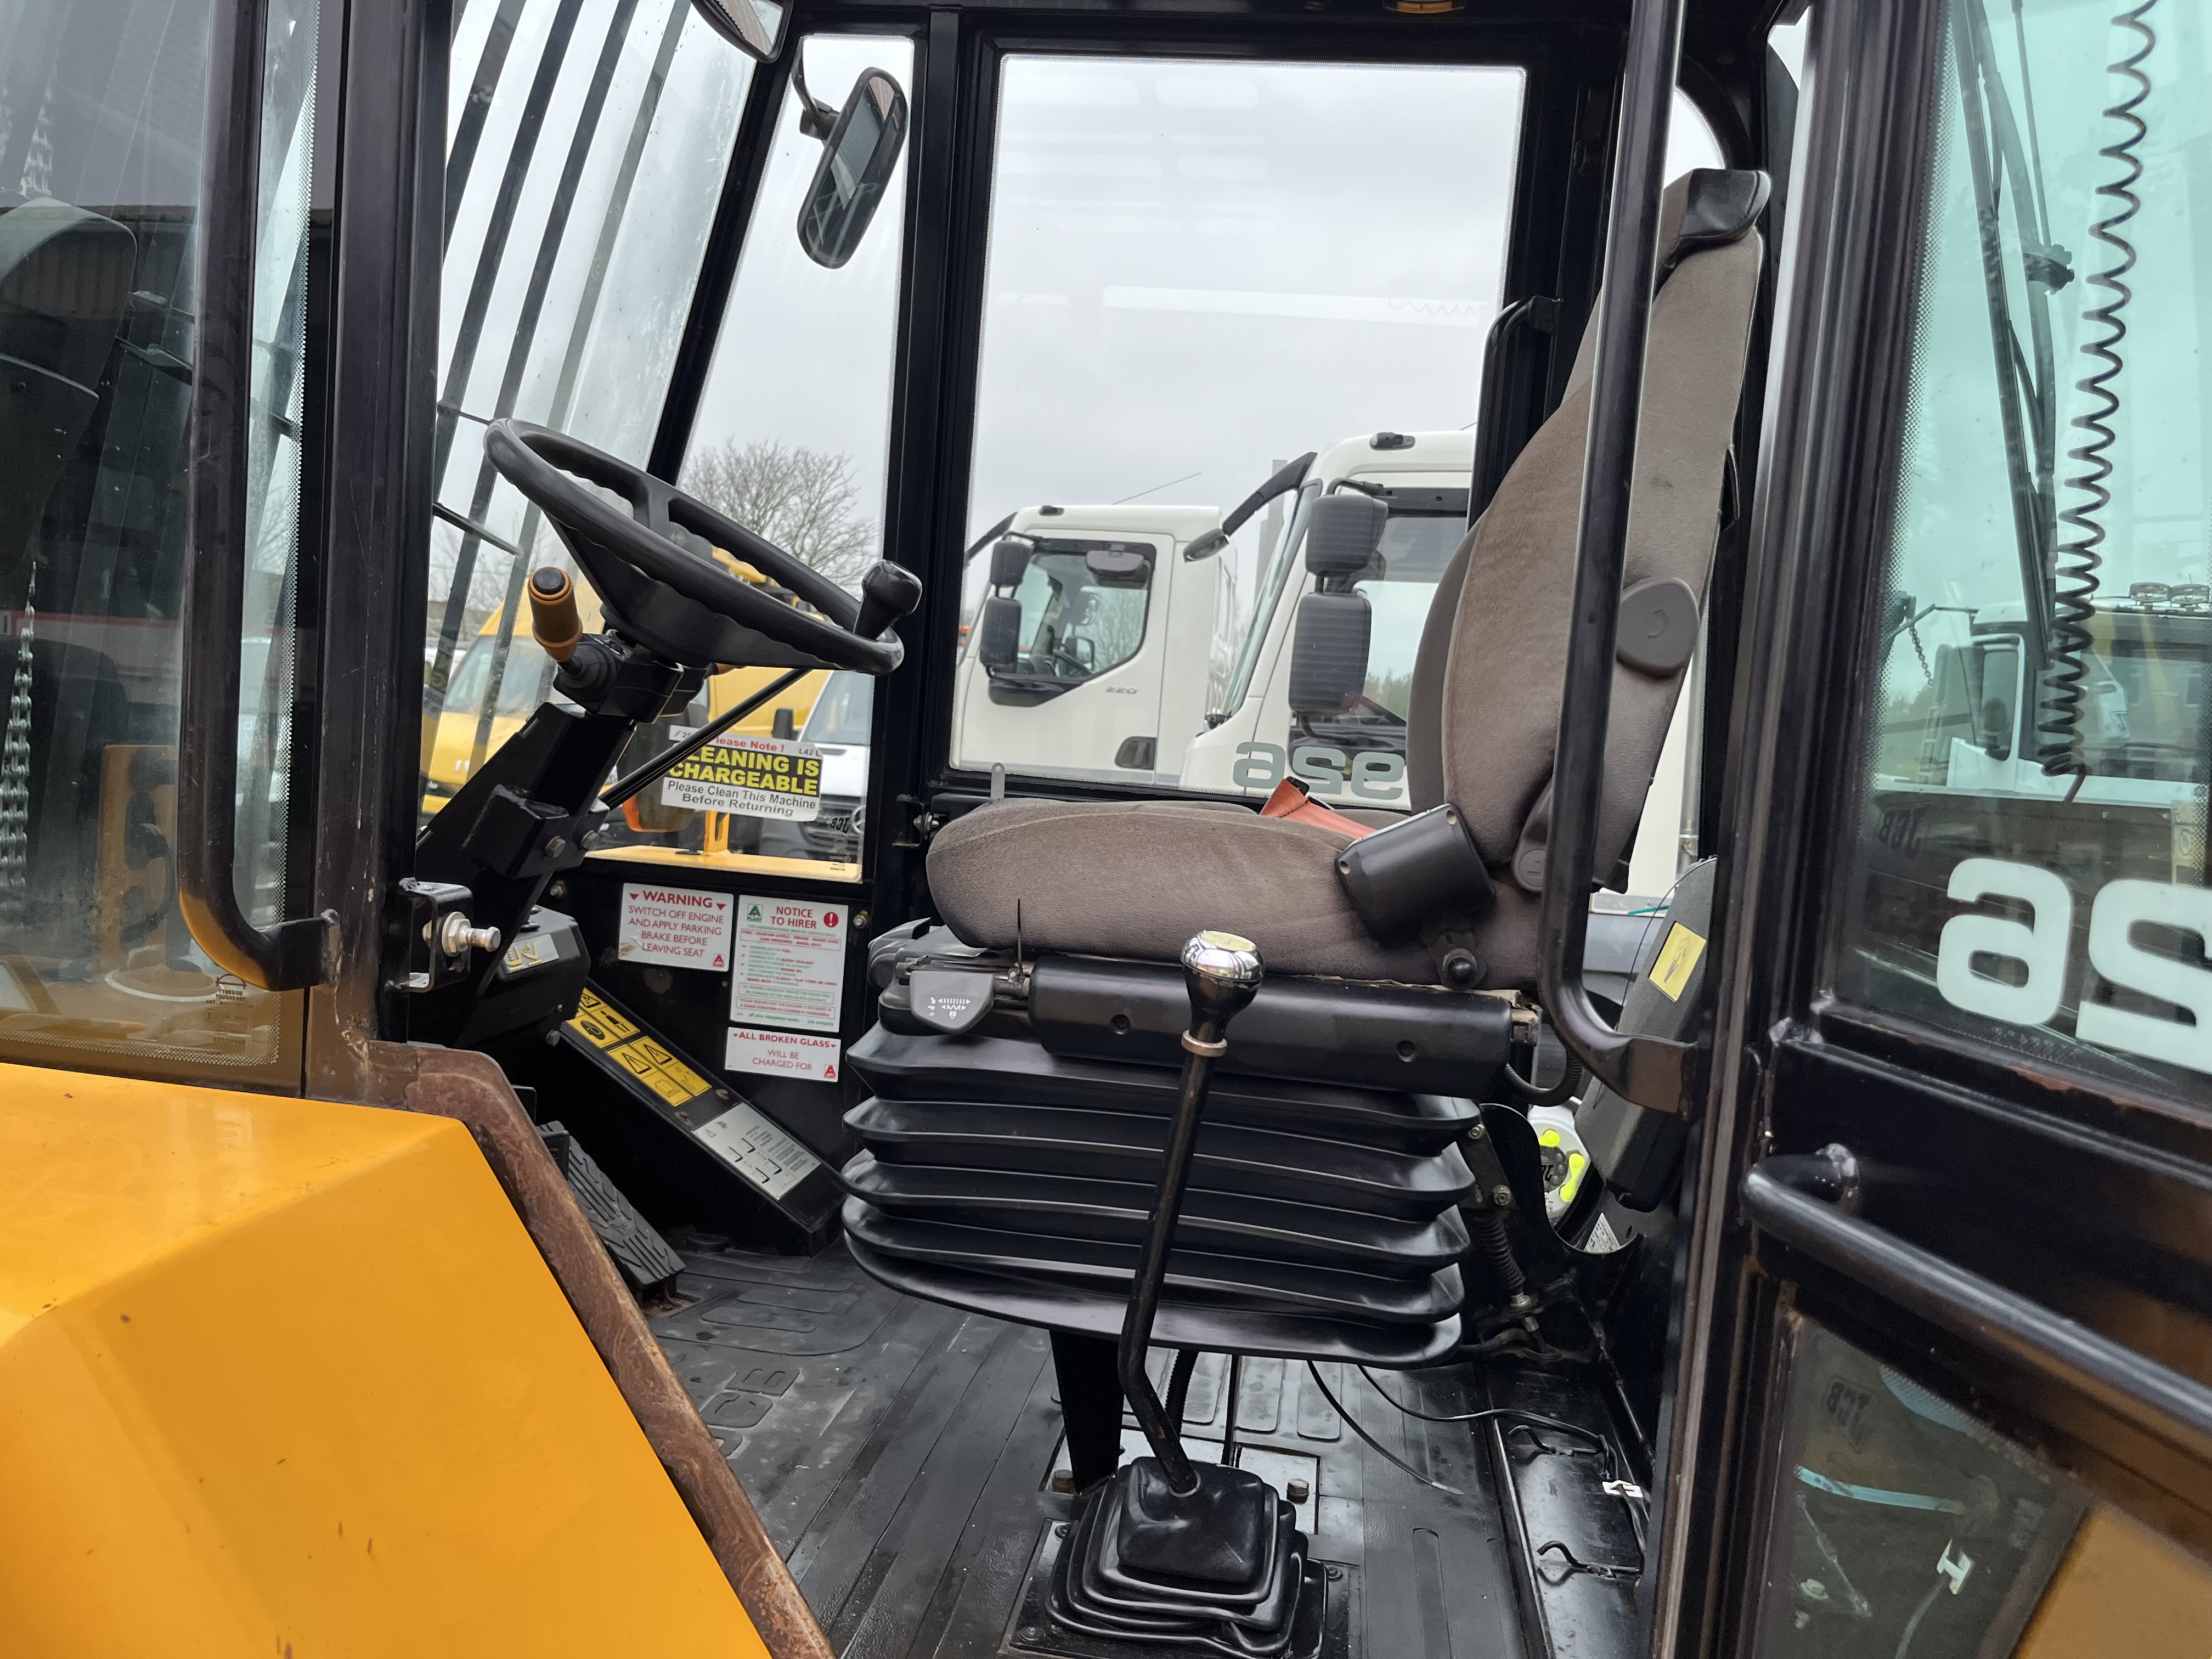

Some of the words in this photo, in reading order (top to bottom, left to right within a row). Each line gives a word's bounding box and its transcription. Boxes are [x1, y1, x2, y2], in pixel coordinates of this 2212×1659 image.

[1106, 686, 1138, 695] 220
[715, 737, 746, 747] lease
[750, 741, 777, 752] Note
[799, 748, 814, 756] L42
[687, 746, 789, 773] EANING
[797, 759, 819, 777] IS
[669, 762, 818, 796] CHARGEABLE
[668, 780, 704, 794] Please
[707, 786, 738, 799] Clean
[742, 790, 765, 802] This
[769, 794, 816, 809] Machine
[682, 793, 724, 806] Before
[729, 799, 793, 817] Returning
[643, 890, 713, 908] WARNING
[629, 905, 666, 917] SWITCH
[669, 910, 686, 919] OFF
[689, 912, 724, 924] ENGINE
[776, 906, 813, 918] NOTICE
[629, 917, 651, 927] AND
[652, 921, 679, 931] APPLY
[681, 924, 722, 935] PARKING
[771, 916, 785, 926] TO
[788, 918, 817, 929] HIRER
[641, 930, 671, 942] BRAKE
[673, 934, 708, 946] BEFORE
[642, 943, 681, 955] LEAVING
[683, 947, 705, 958] SEAT
[738, 1031, 757, 1040] ALL
[759, 1034, 797, 1044] BROKEN
[800, 1038, 830, 1048] GLASS
[768, 1048, 788, 1058] WILL
[752, 1057, 794, 1069] CHARGED
[796, 1062, 812, 1071] FOR
